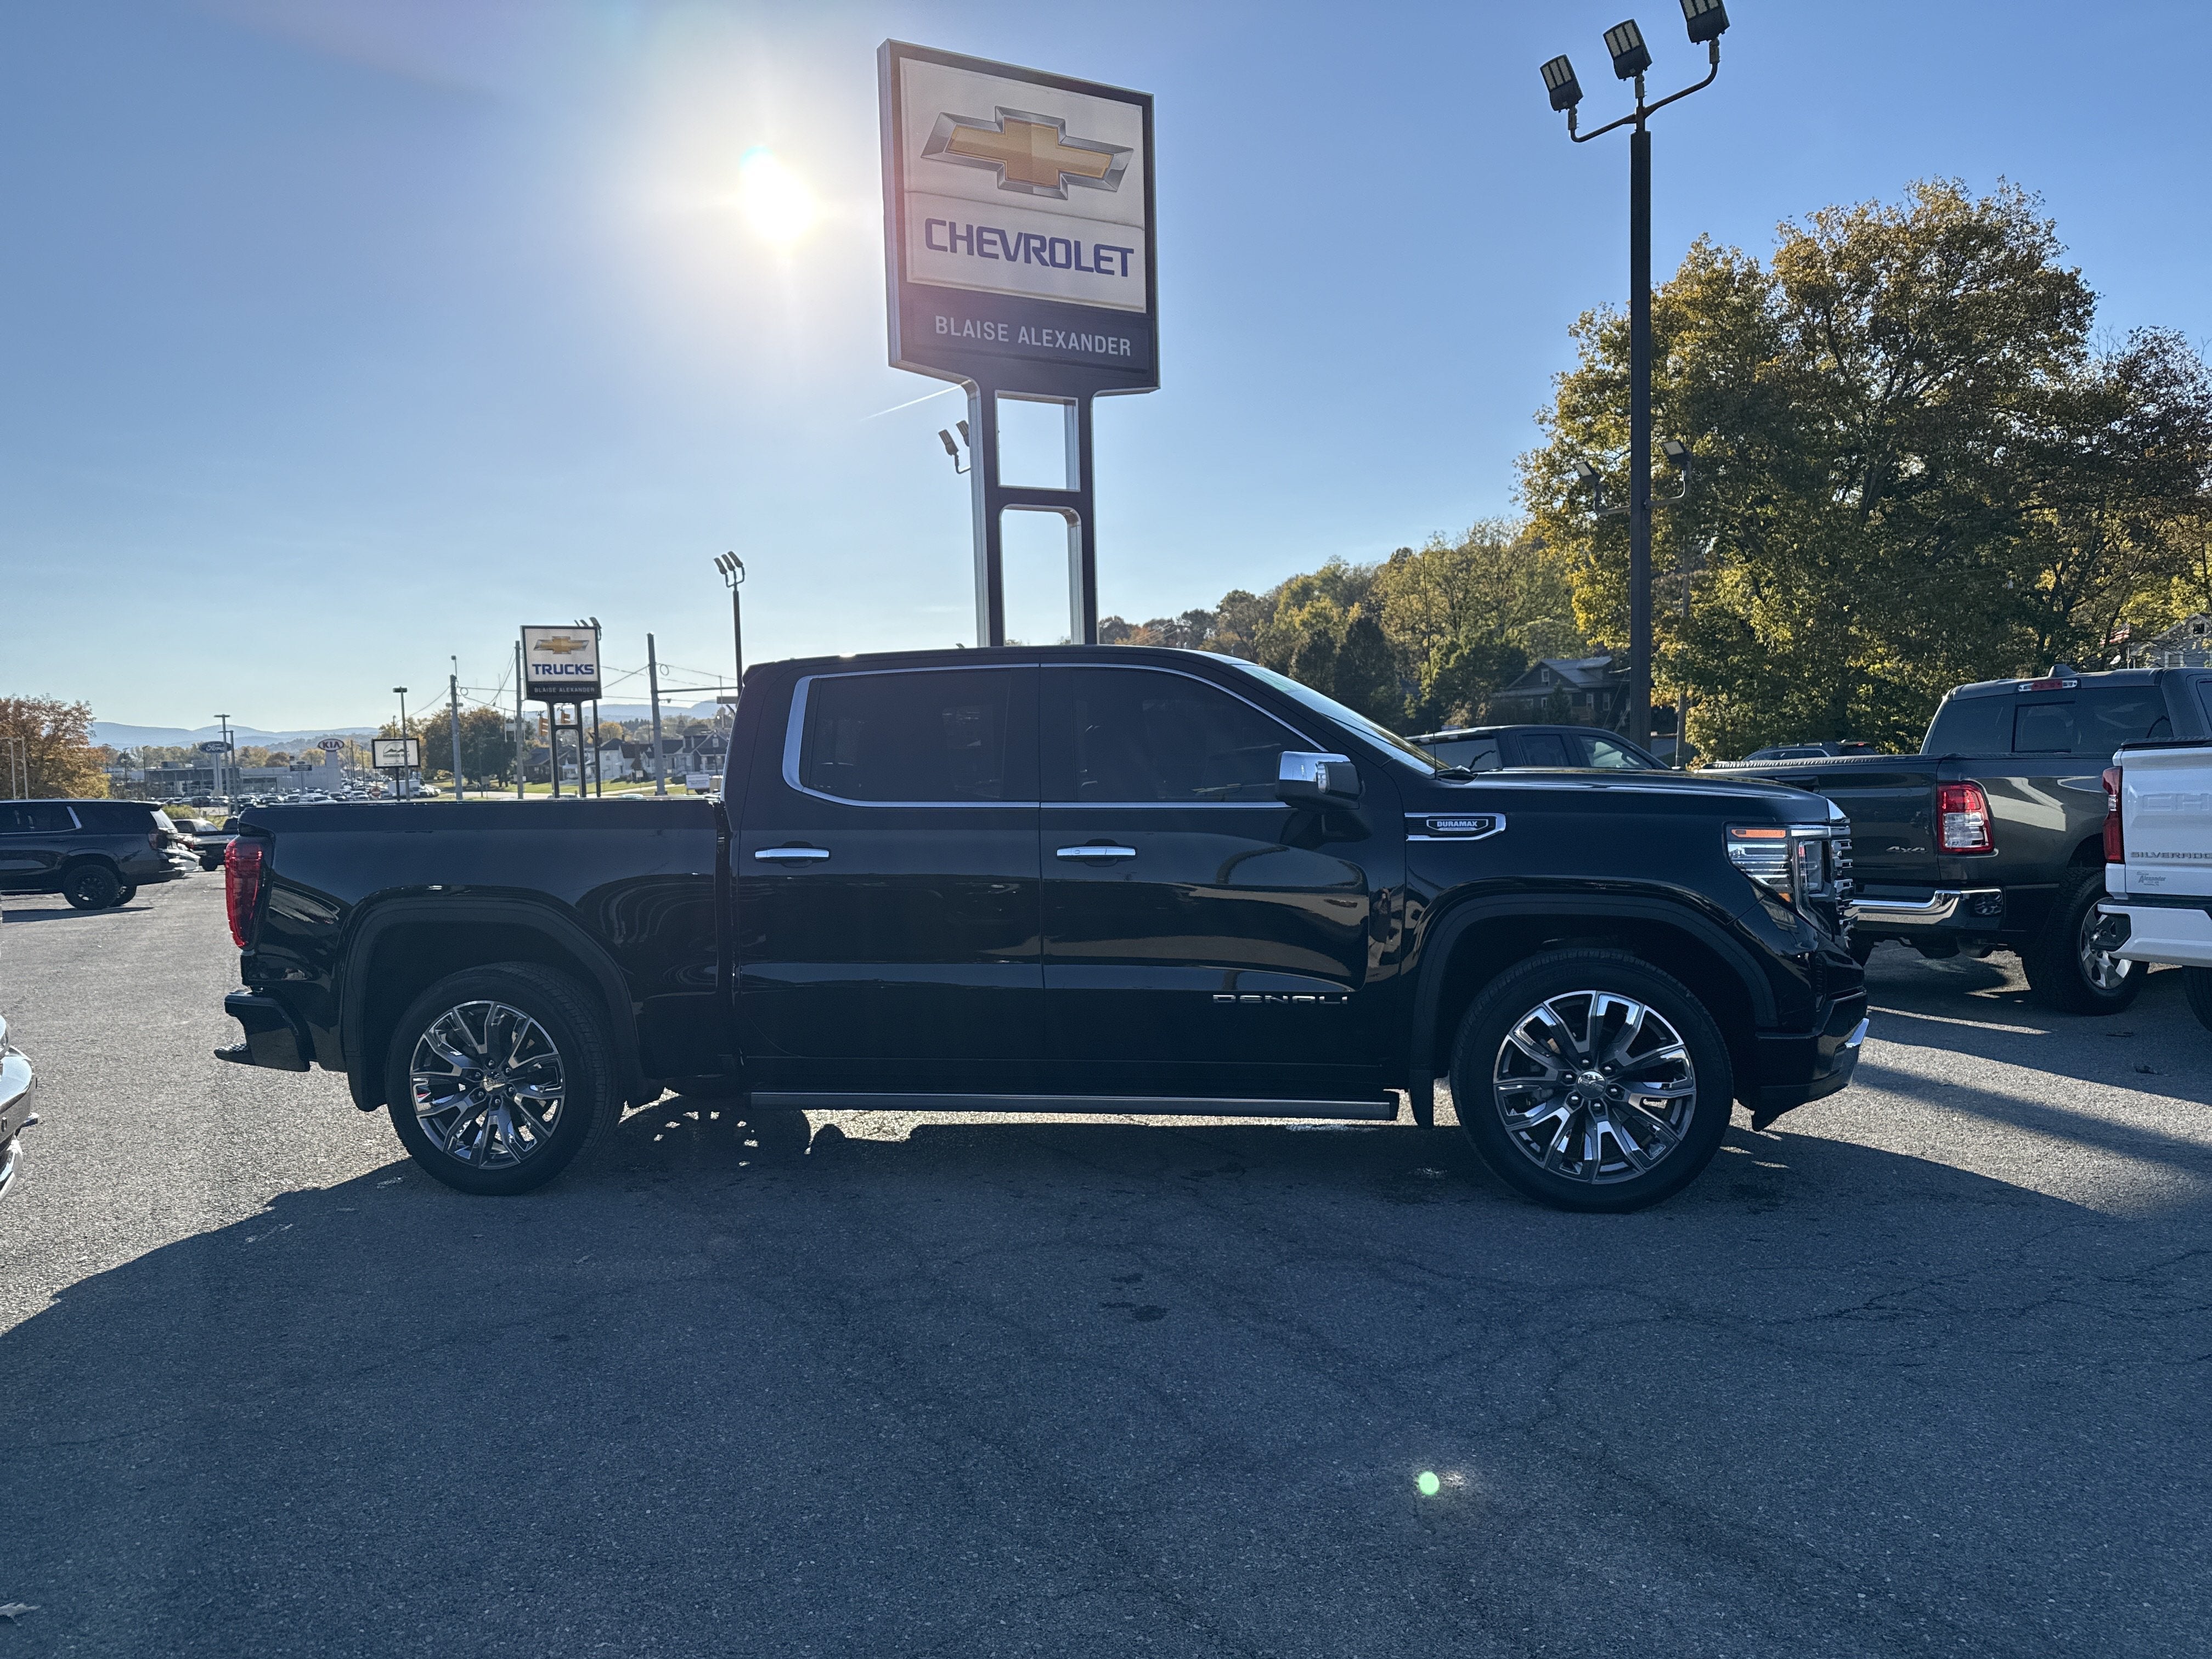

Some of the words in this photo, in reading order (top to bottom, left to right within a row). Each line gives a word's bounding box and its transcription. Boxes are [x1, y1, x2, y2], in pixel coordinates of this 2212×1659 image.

[924, 217, 1135, 278] CHEVROLET
[935, 315, 1009, 342] BLAISE
[1018, 325, 1131, 356] ALEXANDER
[532, 663, 595, 675] TRUCKS
[322, 741, 341, 749] KIA
[1212, 994, 1348, 1005] DENALI
